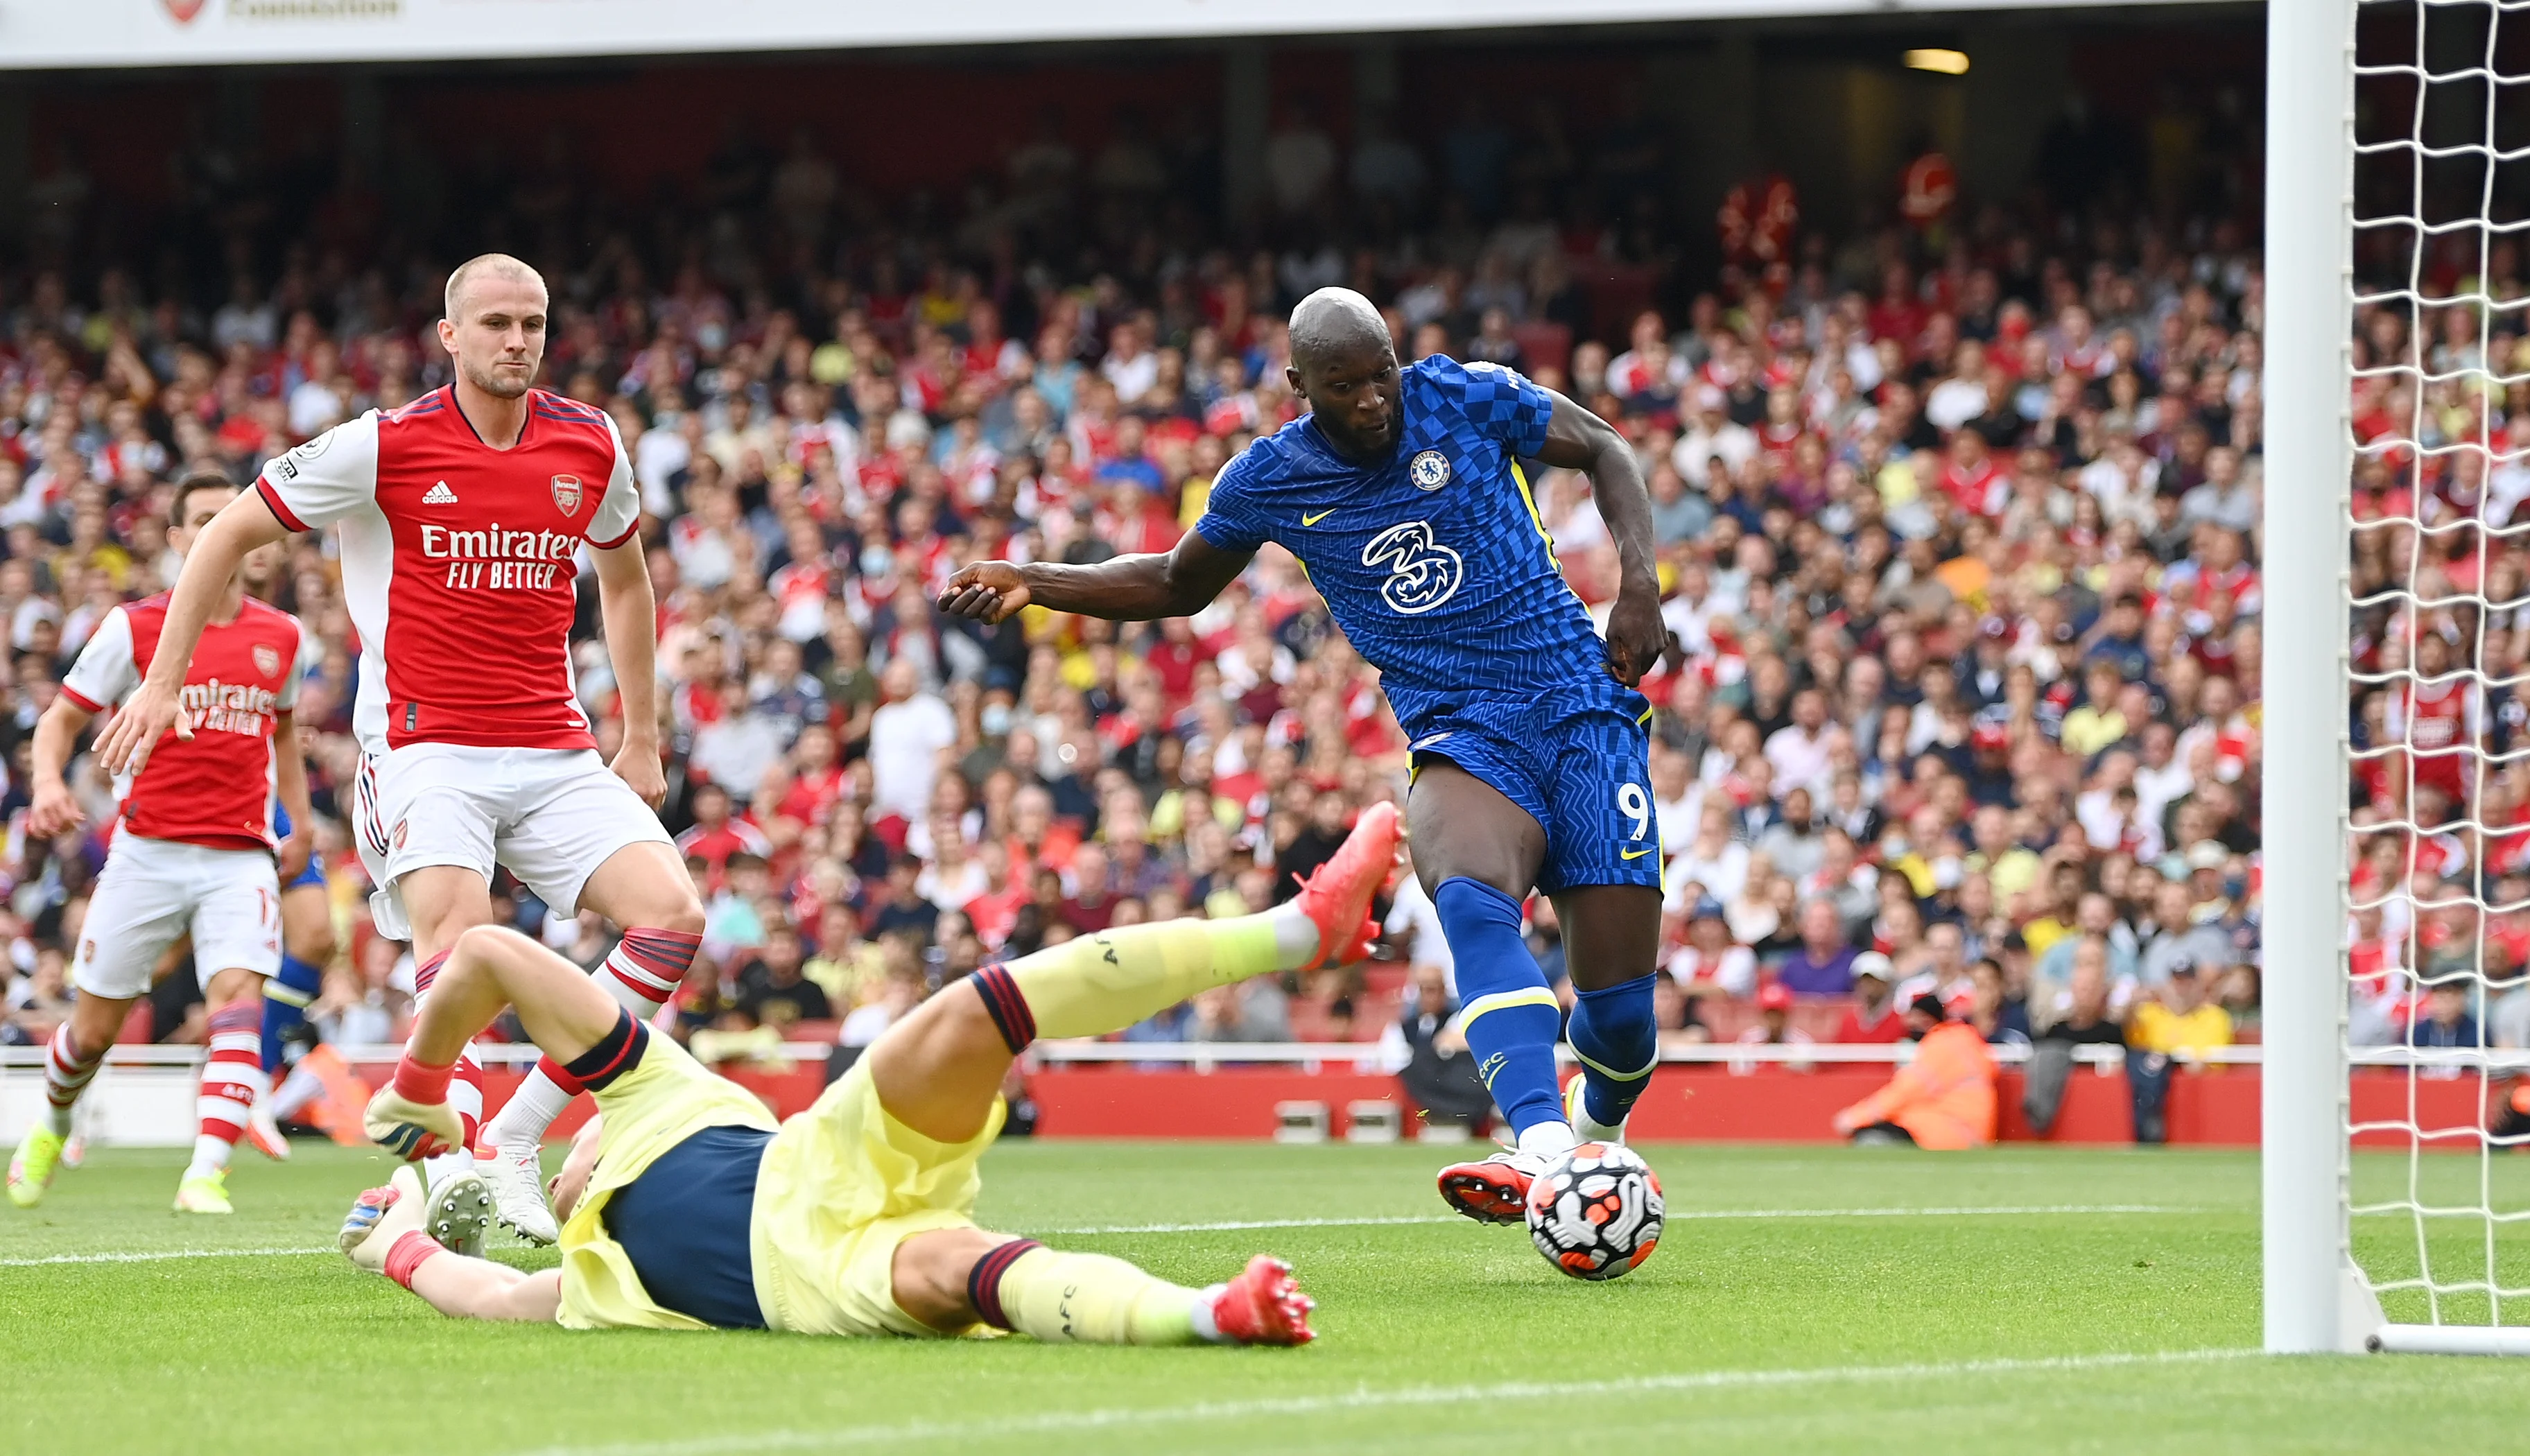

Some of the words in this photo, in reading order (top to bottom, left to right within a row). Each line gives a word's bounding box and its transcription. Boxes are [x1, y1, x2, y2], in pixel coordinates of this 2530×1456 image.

[422, 492, 458, 505] adidas
[420, 522, 578, 560] Emirates
[446, 562, 485, 589] FLY
[489, 561, 557, 589] BETTER
[179, 677, 277, 716] mirate
[1618, 782, 1649, 841] 9
[1095, 936, 1118, 967] AF
[1479, 1051, 1505, 1080] CFC
